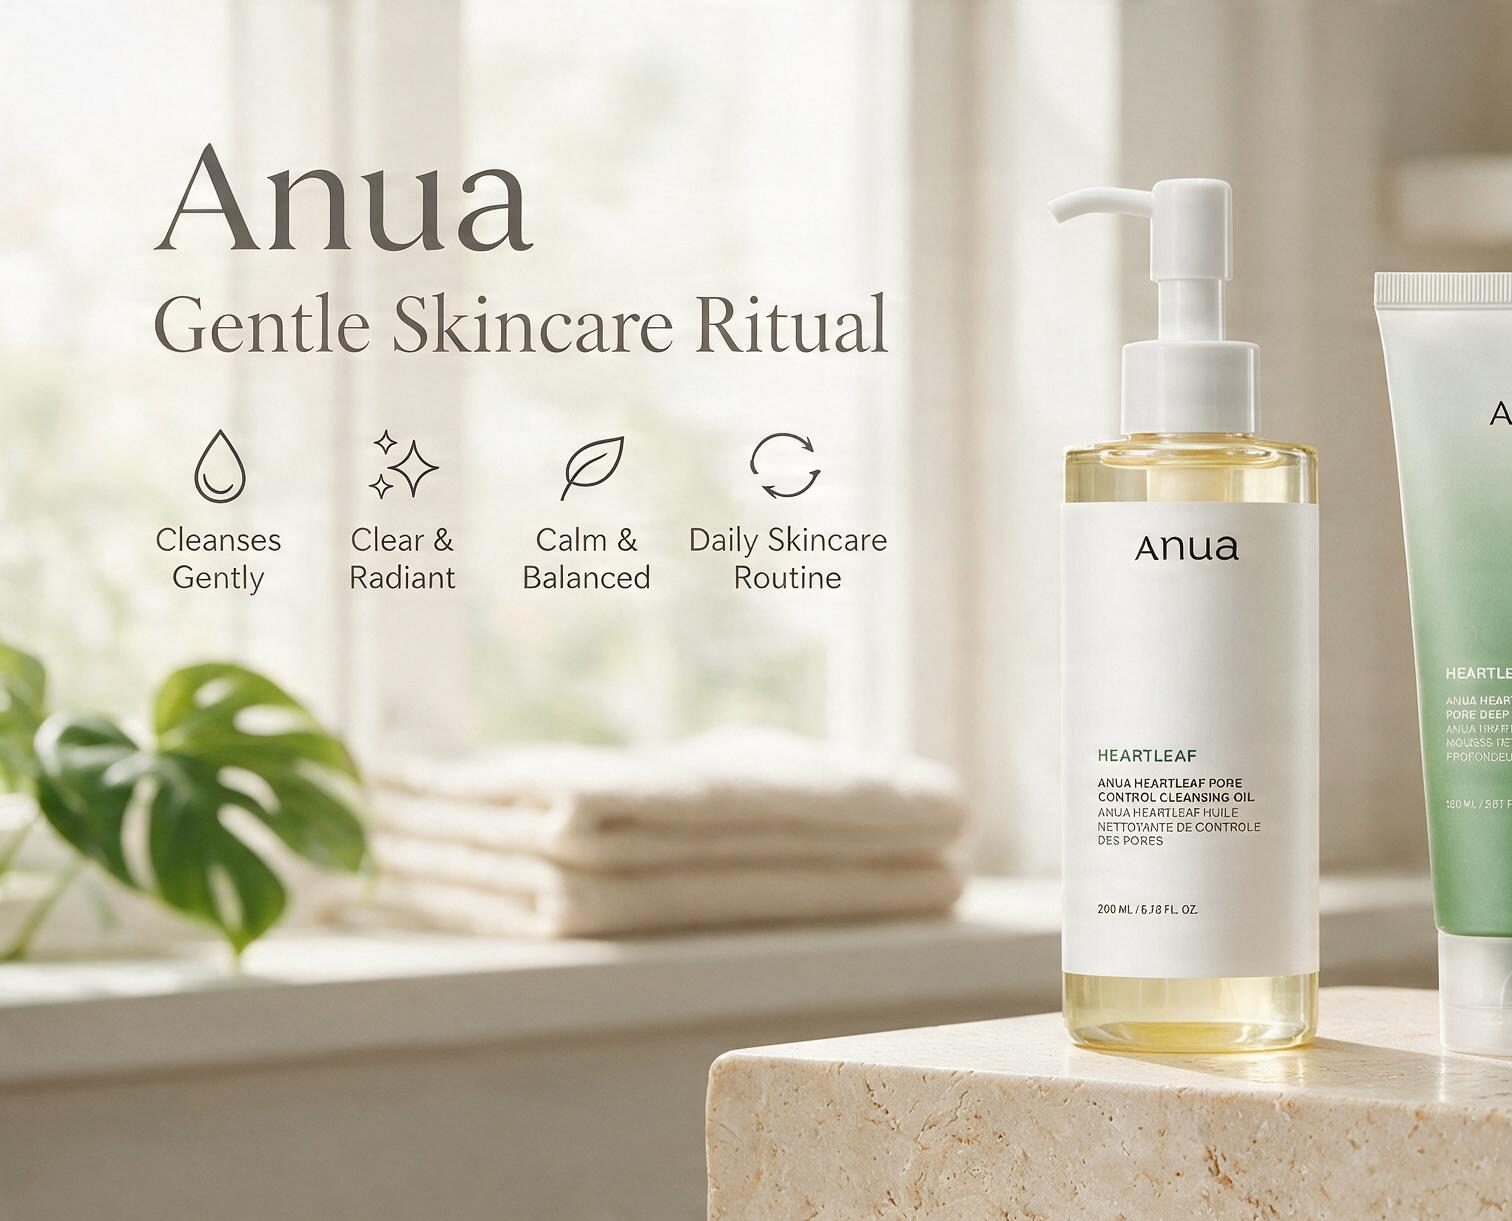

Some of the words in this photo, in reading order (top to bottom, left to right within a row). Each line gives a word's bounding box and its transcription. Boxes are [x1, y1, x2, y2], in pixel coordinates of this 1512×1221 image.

[1135, 535, 1239, 562] Anua
[1446, 696, 1477, 706] ANUA
[1446, 710, 1476, 720] PORE
[1480, 710, 1510, 720] DEEP
[1098, 749, 1197, 762] HEARTLEAF
[1098, 778, 1131, 789] ANUA
[1134, 778, 1205, 788] HEARTLEAF
[1208, 778, 1243, 788] PORE
[1098, 792, 1156, 802] CONTROL
[1159, 792, 1230, 802] CLEANSING
[1233, 792, 1255, 802] OIL
[1098, 808, 1131, 818] ANUA
[1133, 808, 1200, 818] HEARTLEAF
[1203, 808, 1239, 818] HUILE
[1098, 822, 1174, 832] NETTOYANTE
[1176, 822, 1192, 832] DE
[1195, 822, 1261, 832] CONTROLE
[1098, 835, 1120, 846] DES
[1123, 835, 1164, 846] PORES
[1097, 904, 1116, 914] 200
